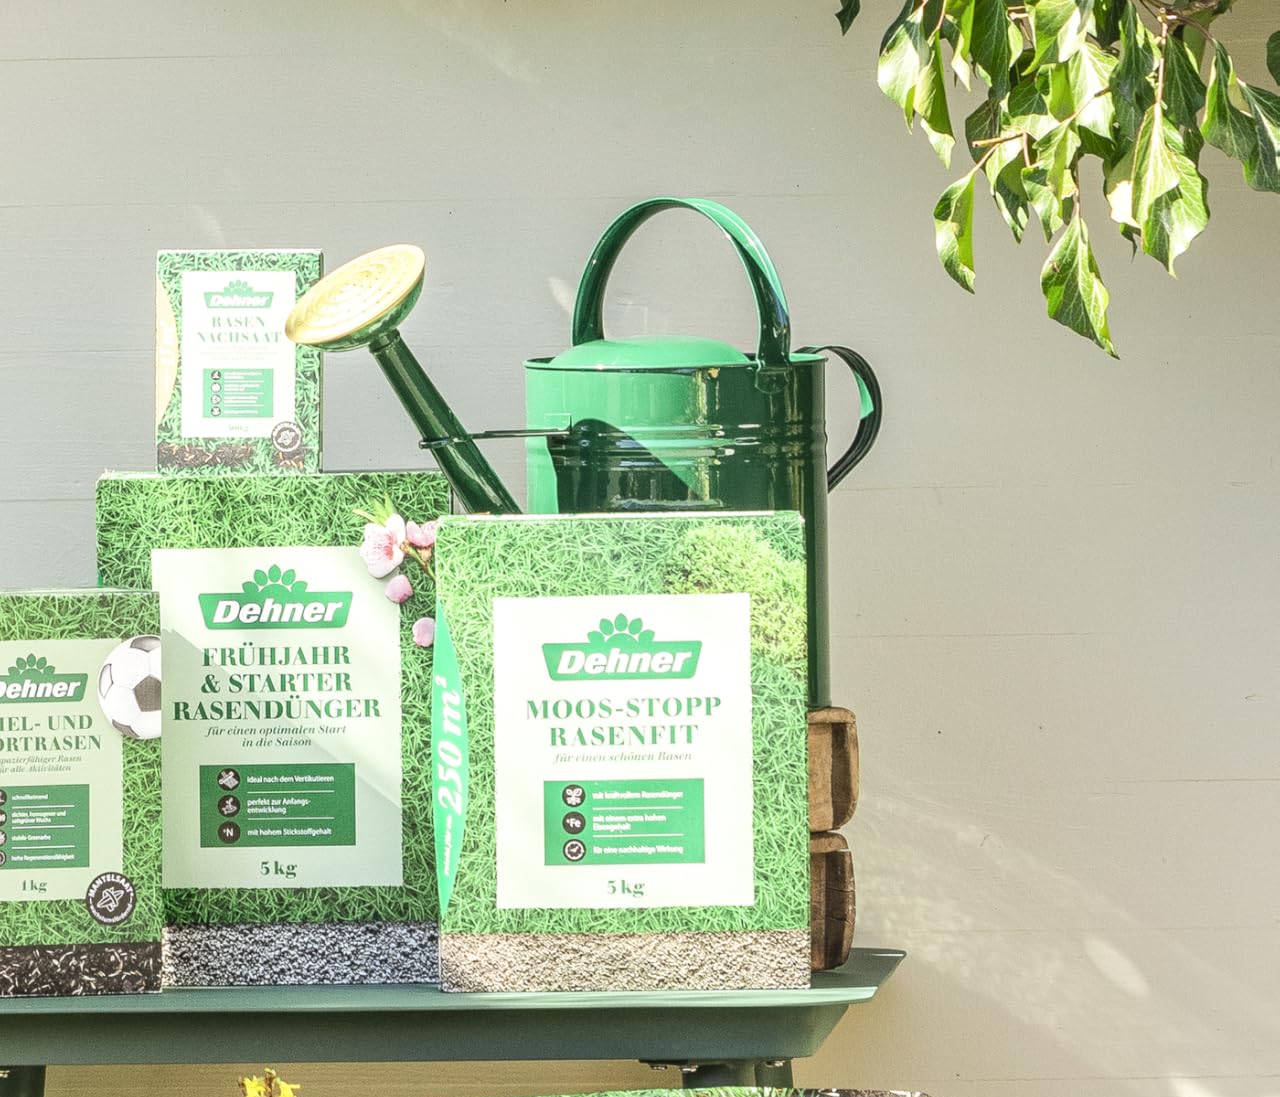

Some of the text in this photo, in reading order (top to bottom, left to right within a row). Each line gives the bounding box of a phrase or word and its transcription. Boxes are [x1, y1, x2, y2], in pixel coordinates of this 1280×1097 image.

[212, 316, 265, 327] RASEN
[197, 331, 282, 342] NACHSAAT
[213, 597, 344, 624] Dehner
[202, 642, 351, 666] FRÜHJAHR
[557, 648, 692, 674] Dehner
[201, 672, 352, 693] & STARTER
[172, 695, 381, 720] RASENDÜNGER
[526, 696, 721, 720] MOOS-STOPP
[48, 714, 93, 730] UND
[205, 724, 346, 737] für einen optimalen Start
[550, 724, 699, 747] RASENFIT
[241, 737, 312, 747] in die Saison
[57, 754, 82, 762] Rasen
[553, 751, 692, 764] für einen schönen Rasen
[10, 765, 24, 773] alle
[26, 764, 71, 773] Aktivitäten
[263, 775, 279, 783] nach
[280, 775, 294, 783] dem
[294, 774, 335, 782] Vertikutieren
[437, 740, 463, 816] 250
[247, 799, 270, 807] perfekt
[282, 798, 311, 807] Anfangs-
[247, 806, 287, 815] entwicklung
[248, 828, 258, 836] mit
[283, 827, 332, 837] Stickstoffgehalt
[260, 860, 298, 879] 5 kg
[22, 880, 47, 893] 1 kg
[607, 879, 645, 898] 5 kg
